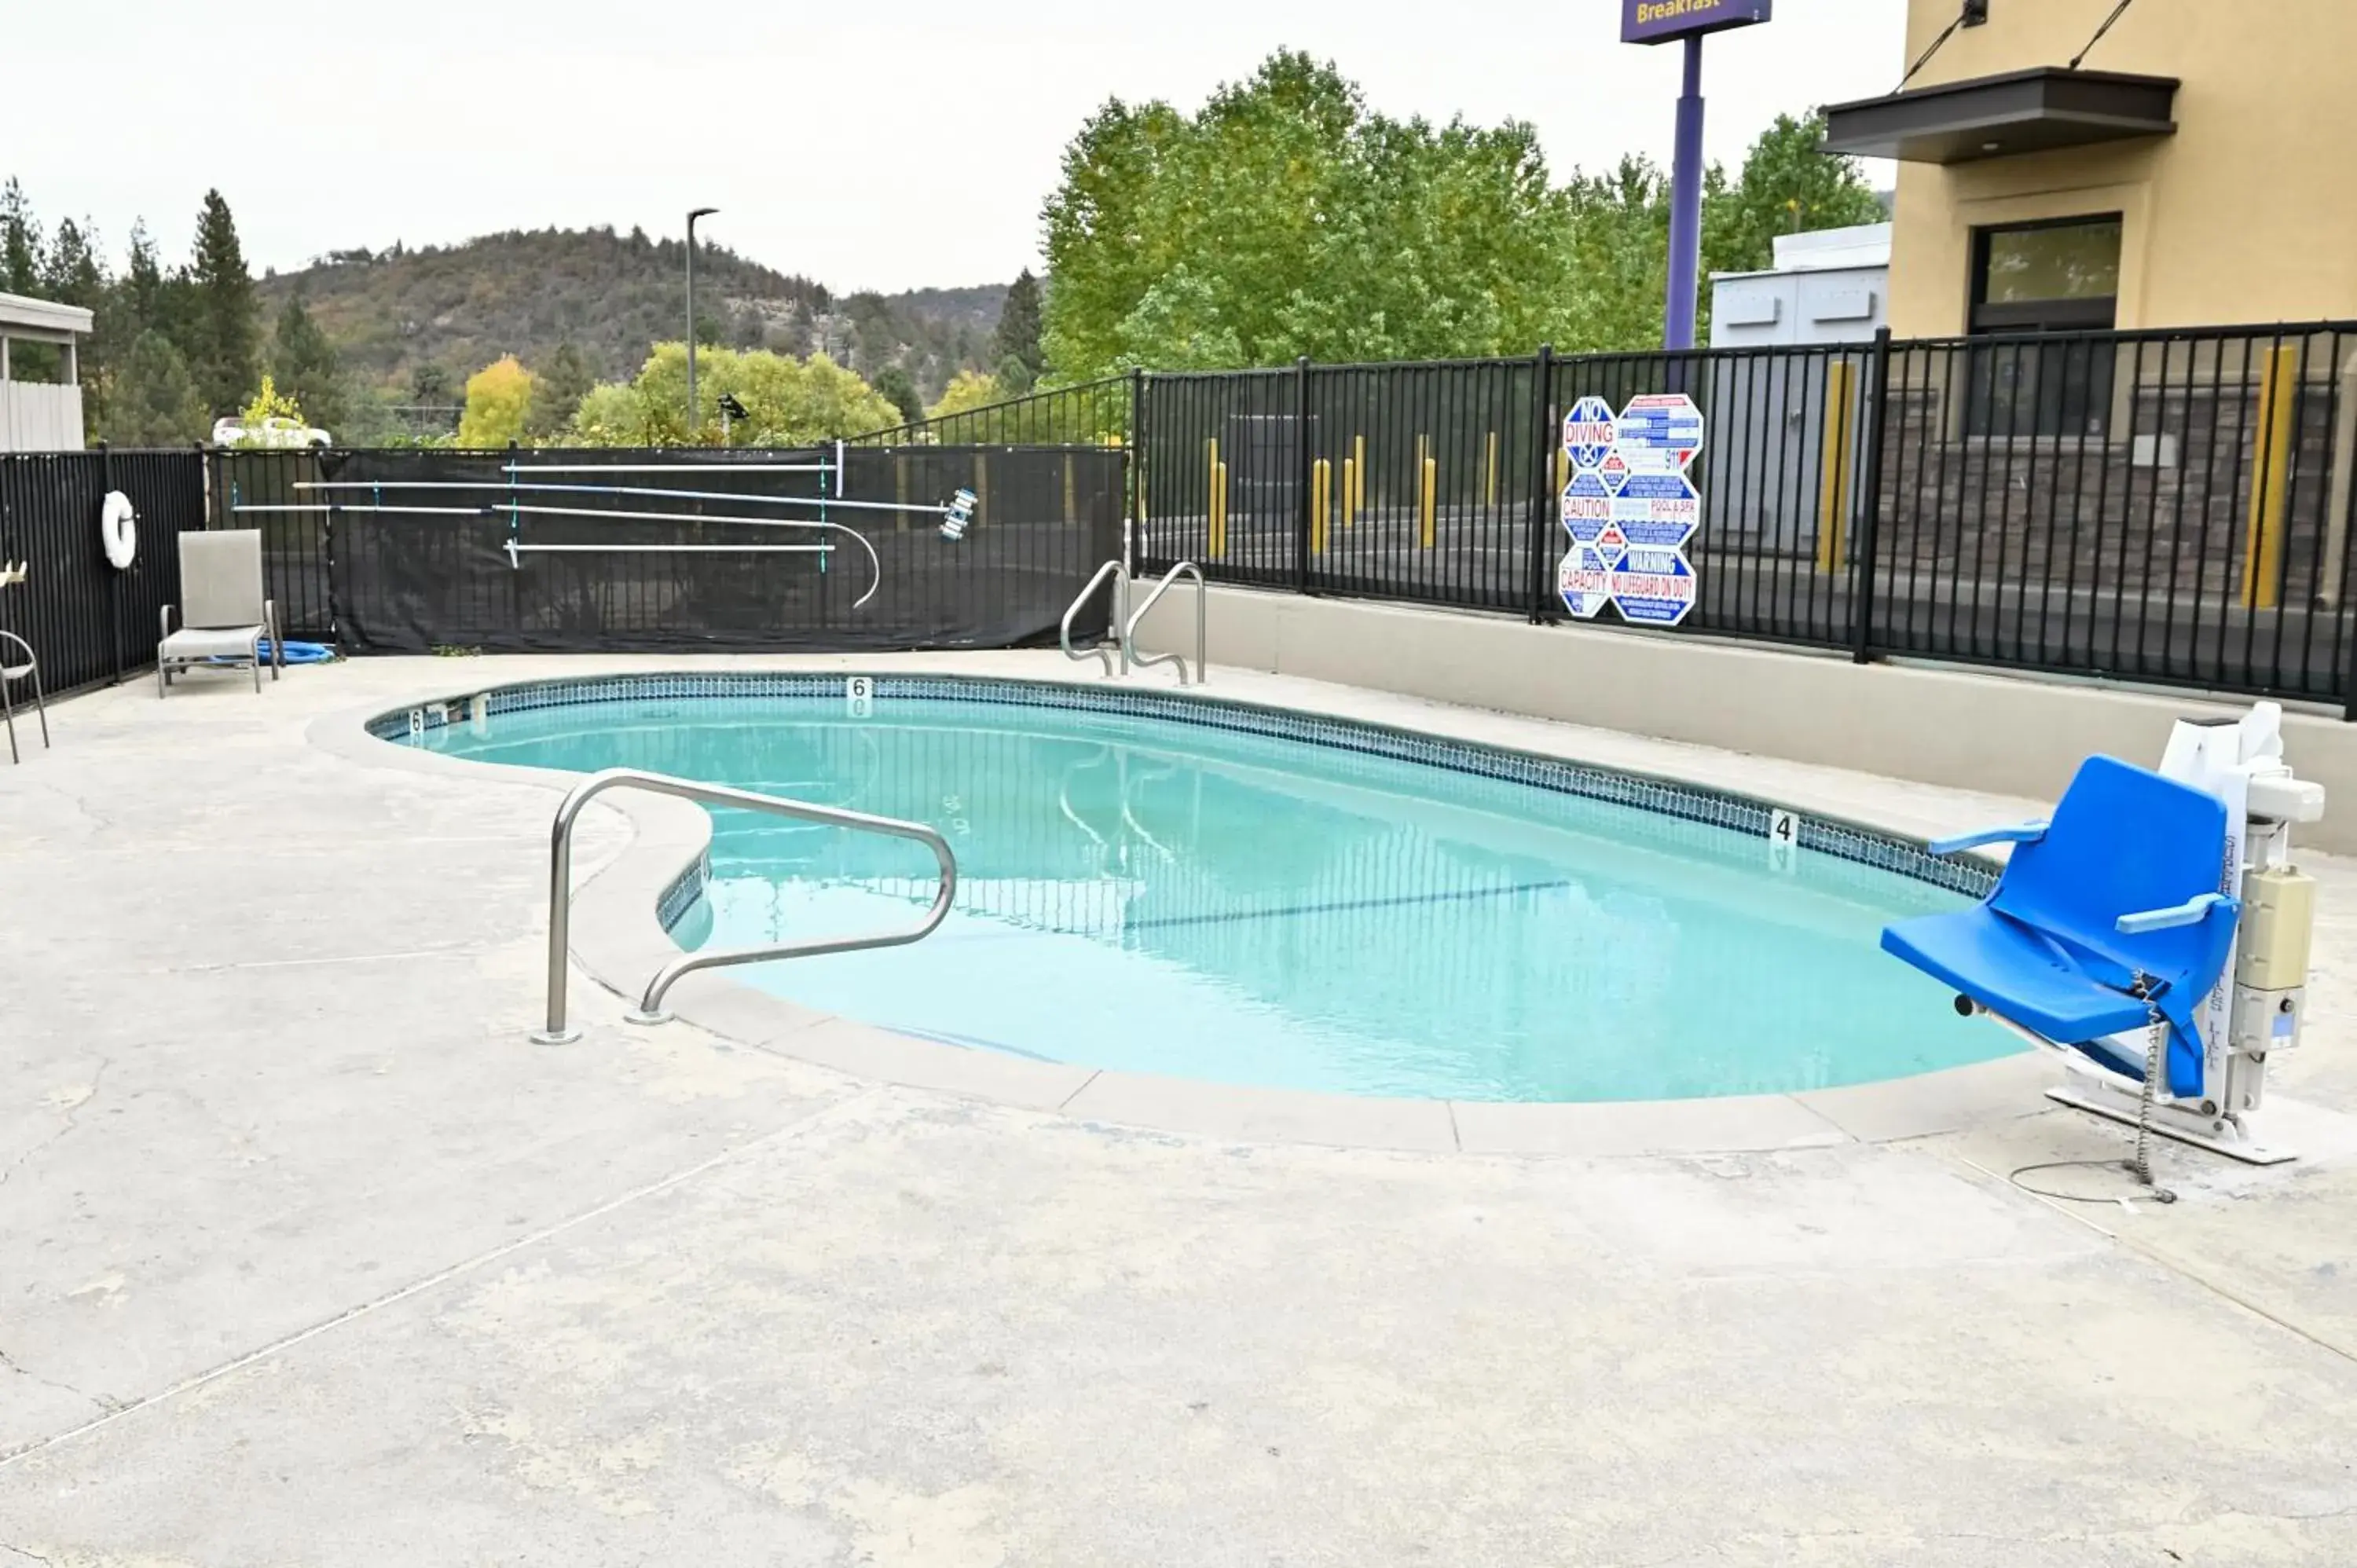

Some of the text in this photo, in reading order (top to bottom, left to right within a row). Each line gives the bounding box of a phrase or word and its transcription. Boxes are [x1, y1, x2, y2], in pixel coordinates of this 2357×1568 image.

[1580, 401, 1602, 421] NO
[1565, 423, 1614, 443] DIVING
[1666, 451, 1680, 470] 911
[1564, 497, 1610, 517] CAUTION
[1680, 501, 1695, 512] SPA
[1628, 551, 1676, 573] WARNING
[1561, 570, 1608, 591] CAPACITY
[1611, 573, 1692, 599] NO LIFEGUARD ON DUTY
[853, 679, 865, 697] 6
[412, 711, 420, 731] 6
[1776, 815, 1791, 841] 4
